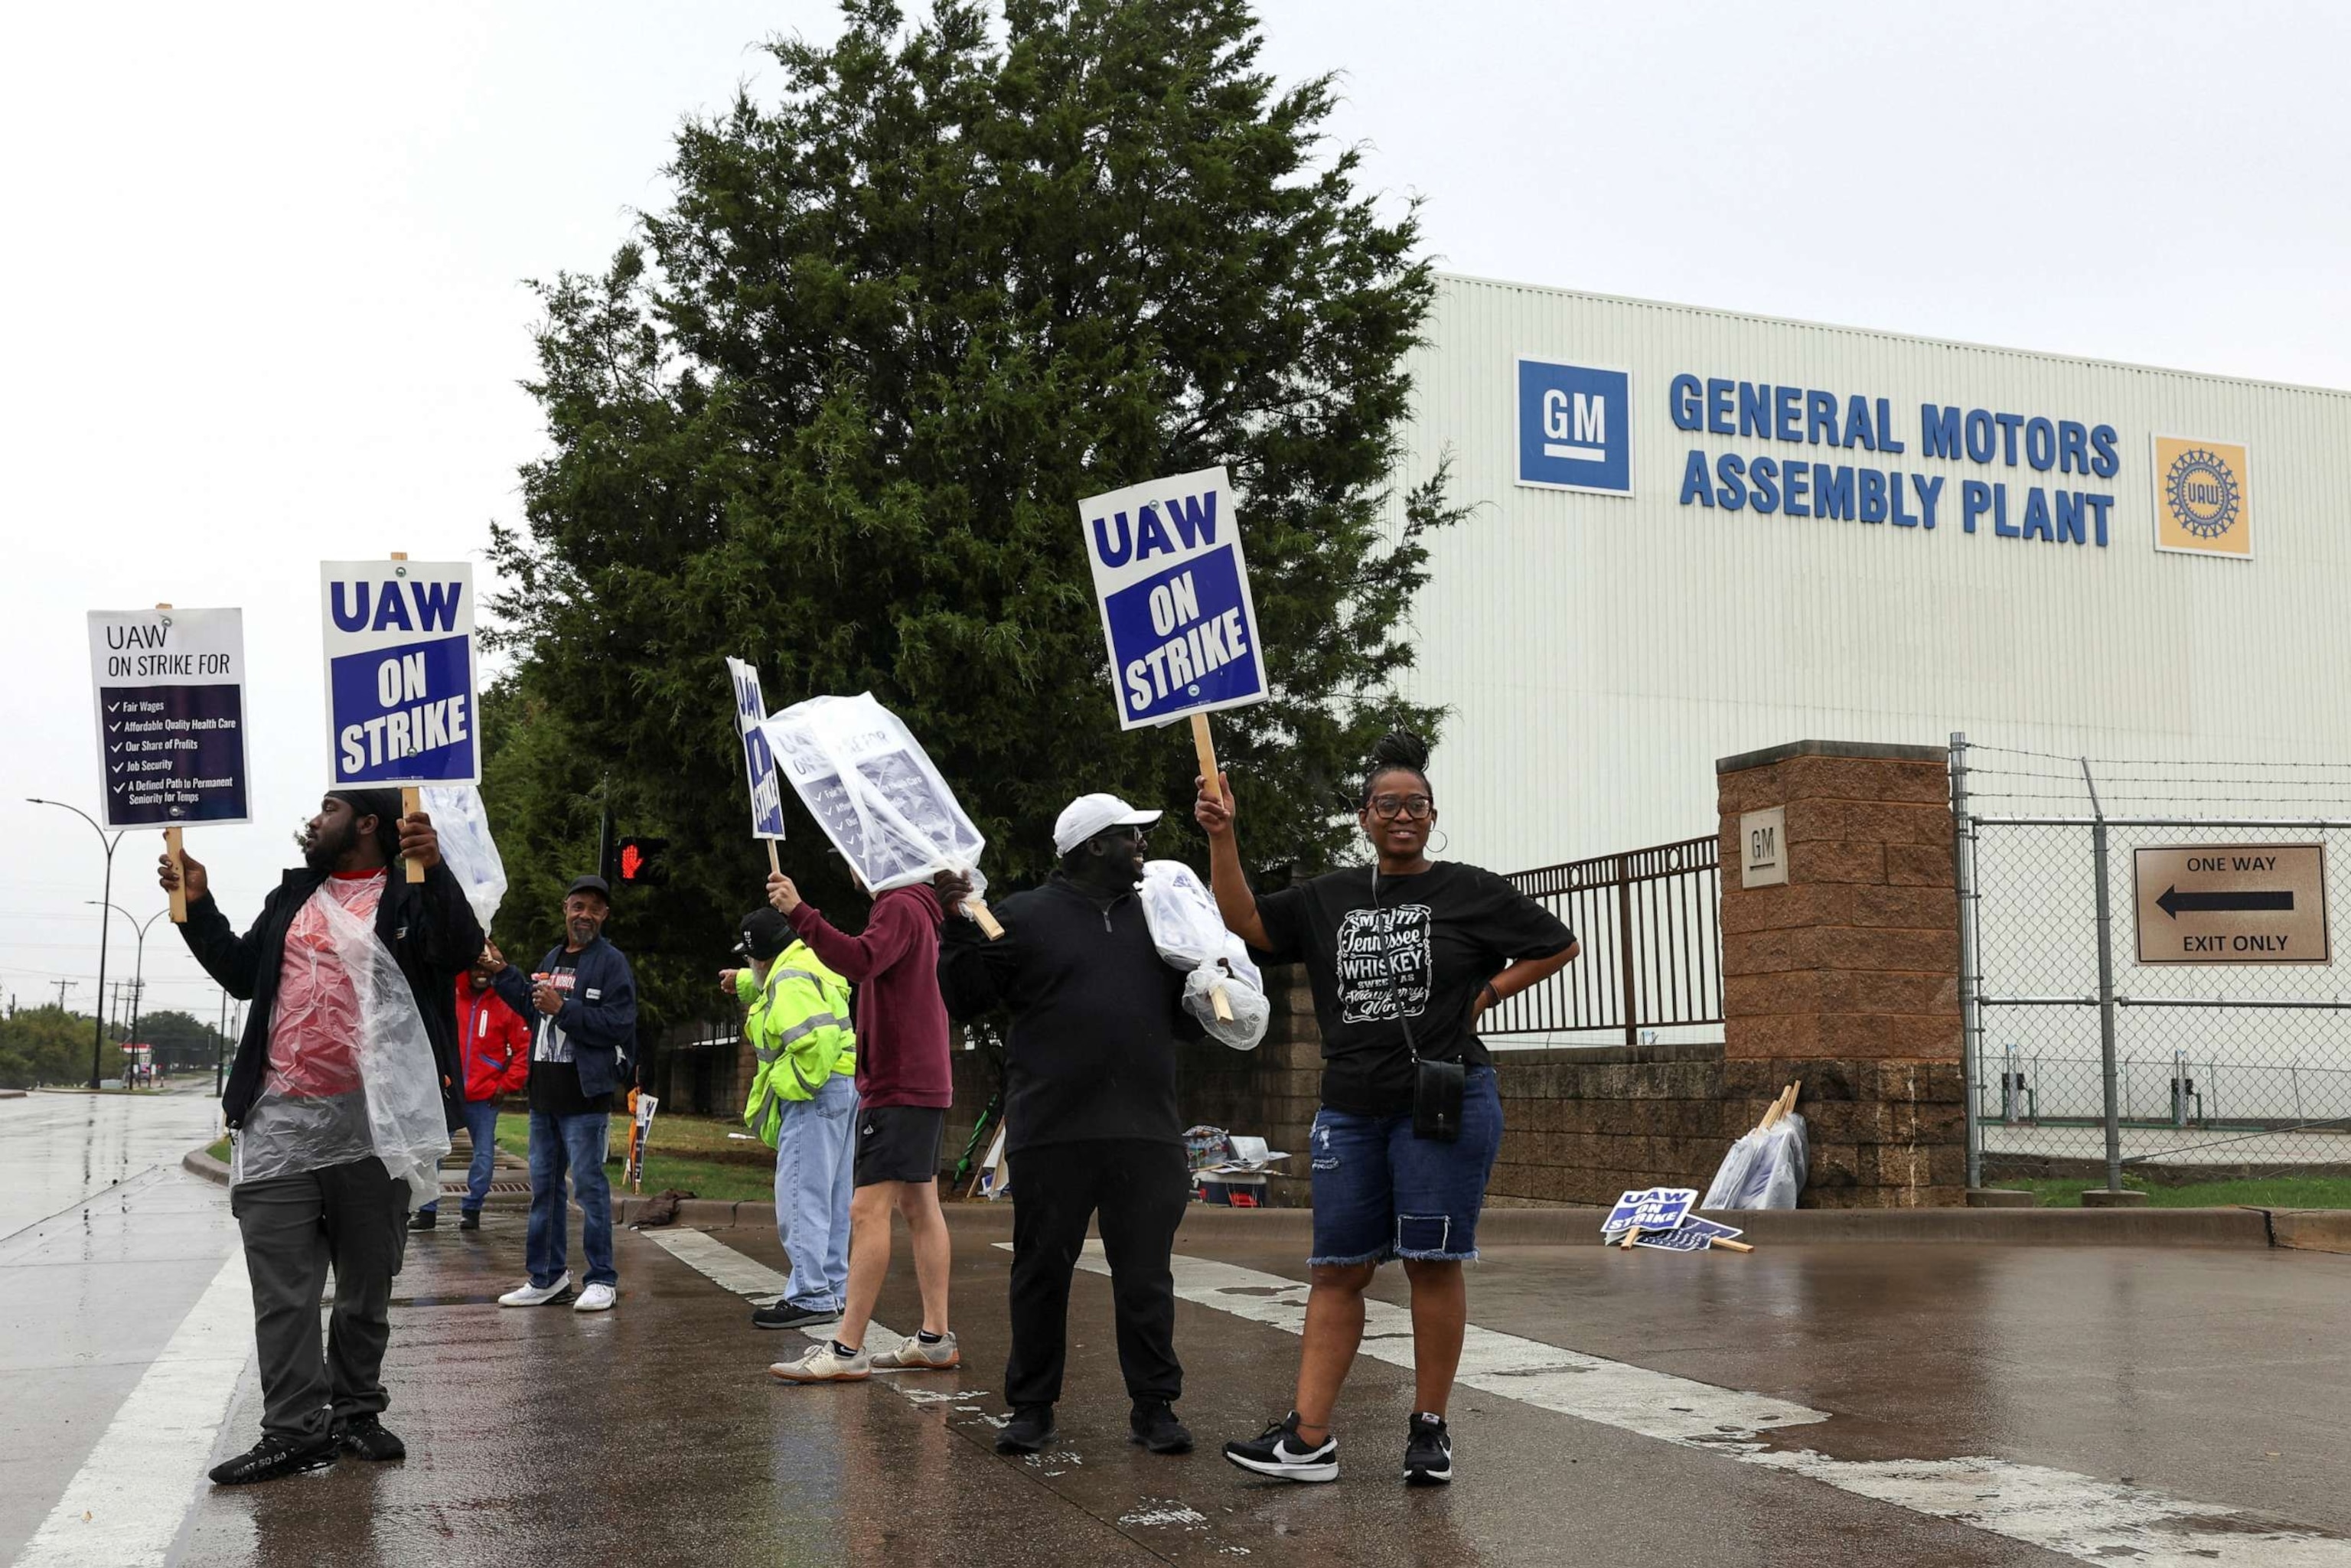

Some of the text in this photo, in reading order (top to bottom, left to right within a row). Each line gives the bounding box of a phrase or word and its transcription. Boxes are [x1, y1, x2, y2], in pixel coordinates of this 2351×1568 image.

[1544, 389, 1605, 444] GM
[1670, 373, 2119, 478] GENERAL MOTORS
[1680, 450, 2115, 547] ASSEMBLY PLANT
[2188, 483, 2219, 505] UAW
[1092, 491, 1217, 568] UAW
[331, 581, 462, 633] UAW
[1149, 571, 1199, 637] ON
[106, 624, 168, 650] UAW
[108, 654, 230, 676] ON STRIKE FOR
[1126, 606, 1247, 711] STRIKE
[377, 651, 426, 708] ON
[122, 701, 165, 712] Fair Wages
[124, 718, 236, 732] Affordable Quality Health Care
[341, 694, 467, 774] STRIKE
[126, 738, 198, 752] Our Share of Profits
[126, 759, 173, 772] Job Security
[128, 777, 233, 791] A Defined Path to Permanent
[129, 791, 199, 805] Seniority for Temps
[1752, 826, 1775, 859] GM
[2187, 856, 2277, 872] ONE WAY
[2183, 935, 2288, 951] EXIT ONLY
[1342, 950, 1423, 980] WHISKEY
[1357, 973, 1415, 989] SWEE AS
[1345, 986, 1424, 1004] Strawbrry
[1623, 1191, 1690, 1204] UAW
[1609, 1211, 1677, 1230] STRIKE
[1635, 1204, 1663, 1215] ON
